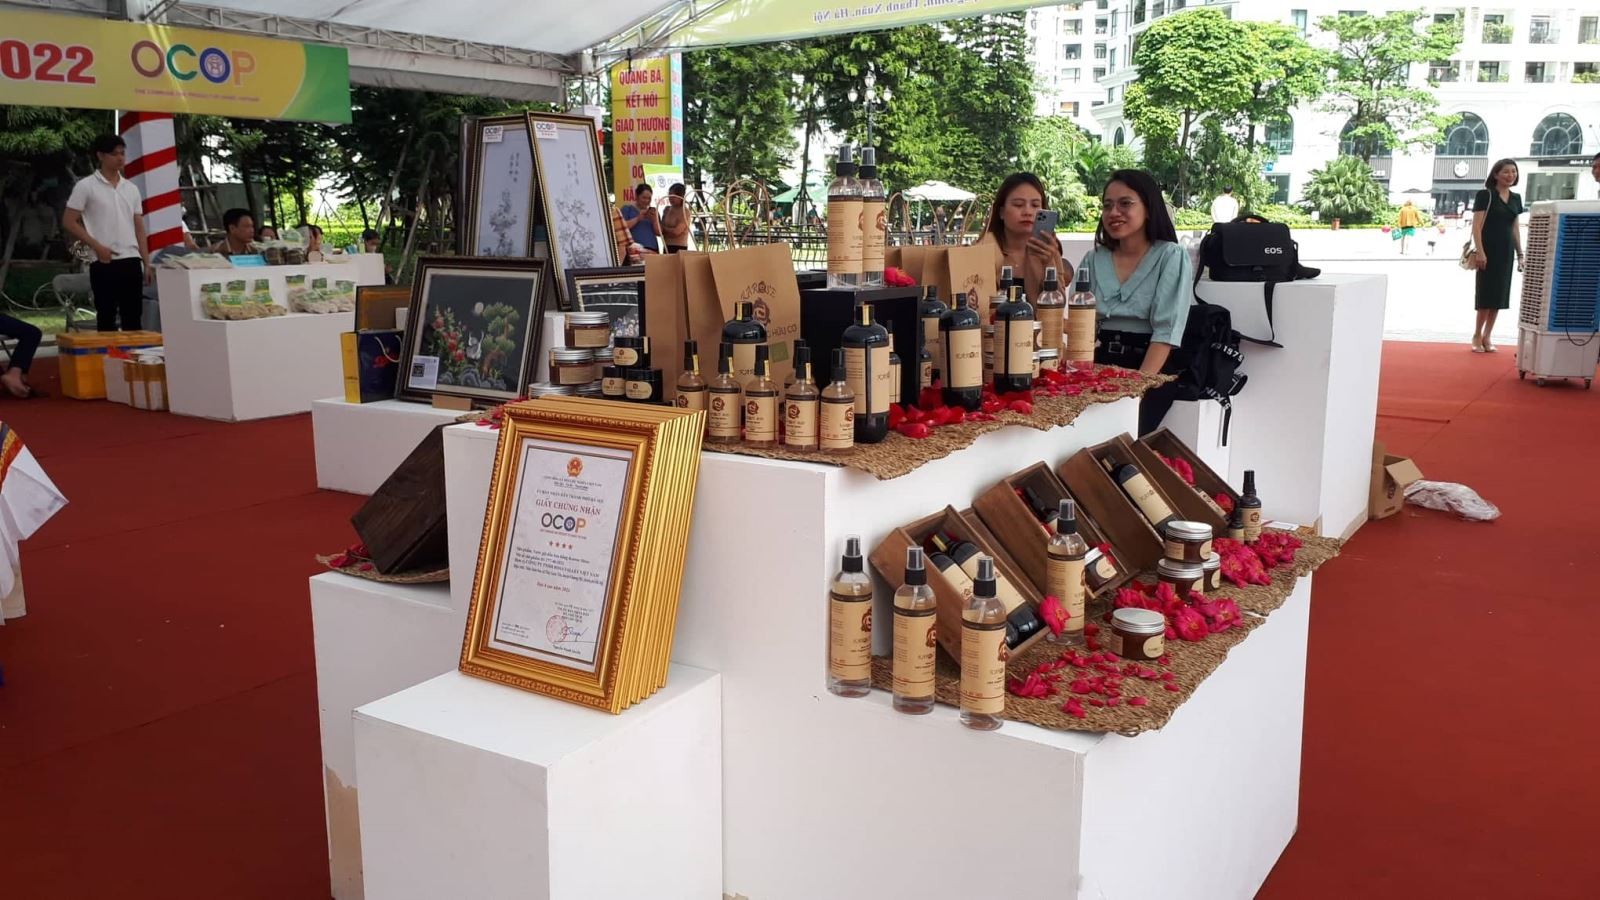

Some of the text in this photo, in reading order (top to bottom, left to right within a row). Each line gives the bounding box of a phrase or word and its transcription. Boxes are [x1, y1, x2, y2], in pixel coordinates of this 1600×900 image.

[131, 40, 256, 86] OCOP
[626, 90, 658, 108] KẾT NỐI
[615, 116, 670, 132] GIAO THƯƠNG
[621, 136, 665, 155] SẢN PHẨM
[1264, 247, 1283, 255] EOS
[541, 512, 587, 533] OCOP
